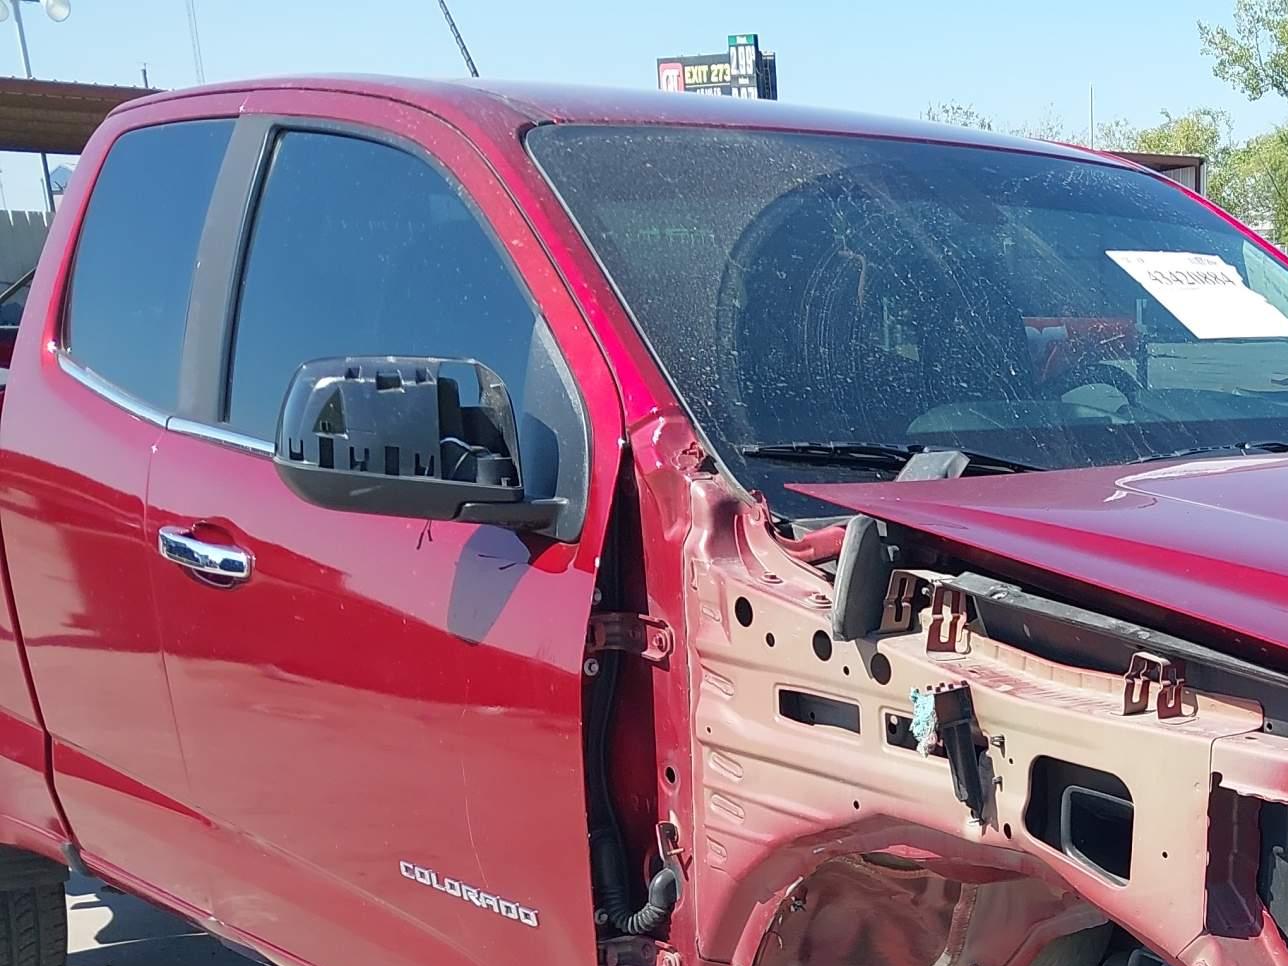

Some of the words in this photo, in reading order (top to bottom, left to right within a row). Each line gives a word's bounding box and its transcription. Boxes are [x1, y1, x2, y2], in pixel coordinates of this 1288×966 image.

[684, 65, 708, 84] EXIT
[710, 63, 731, 83] 273
[399, 860, 540, 928] COLORADO
